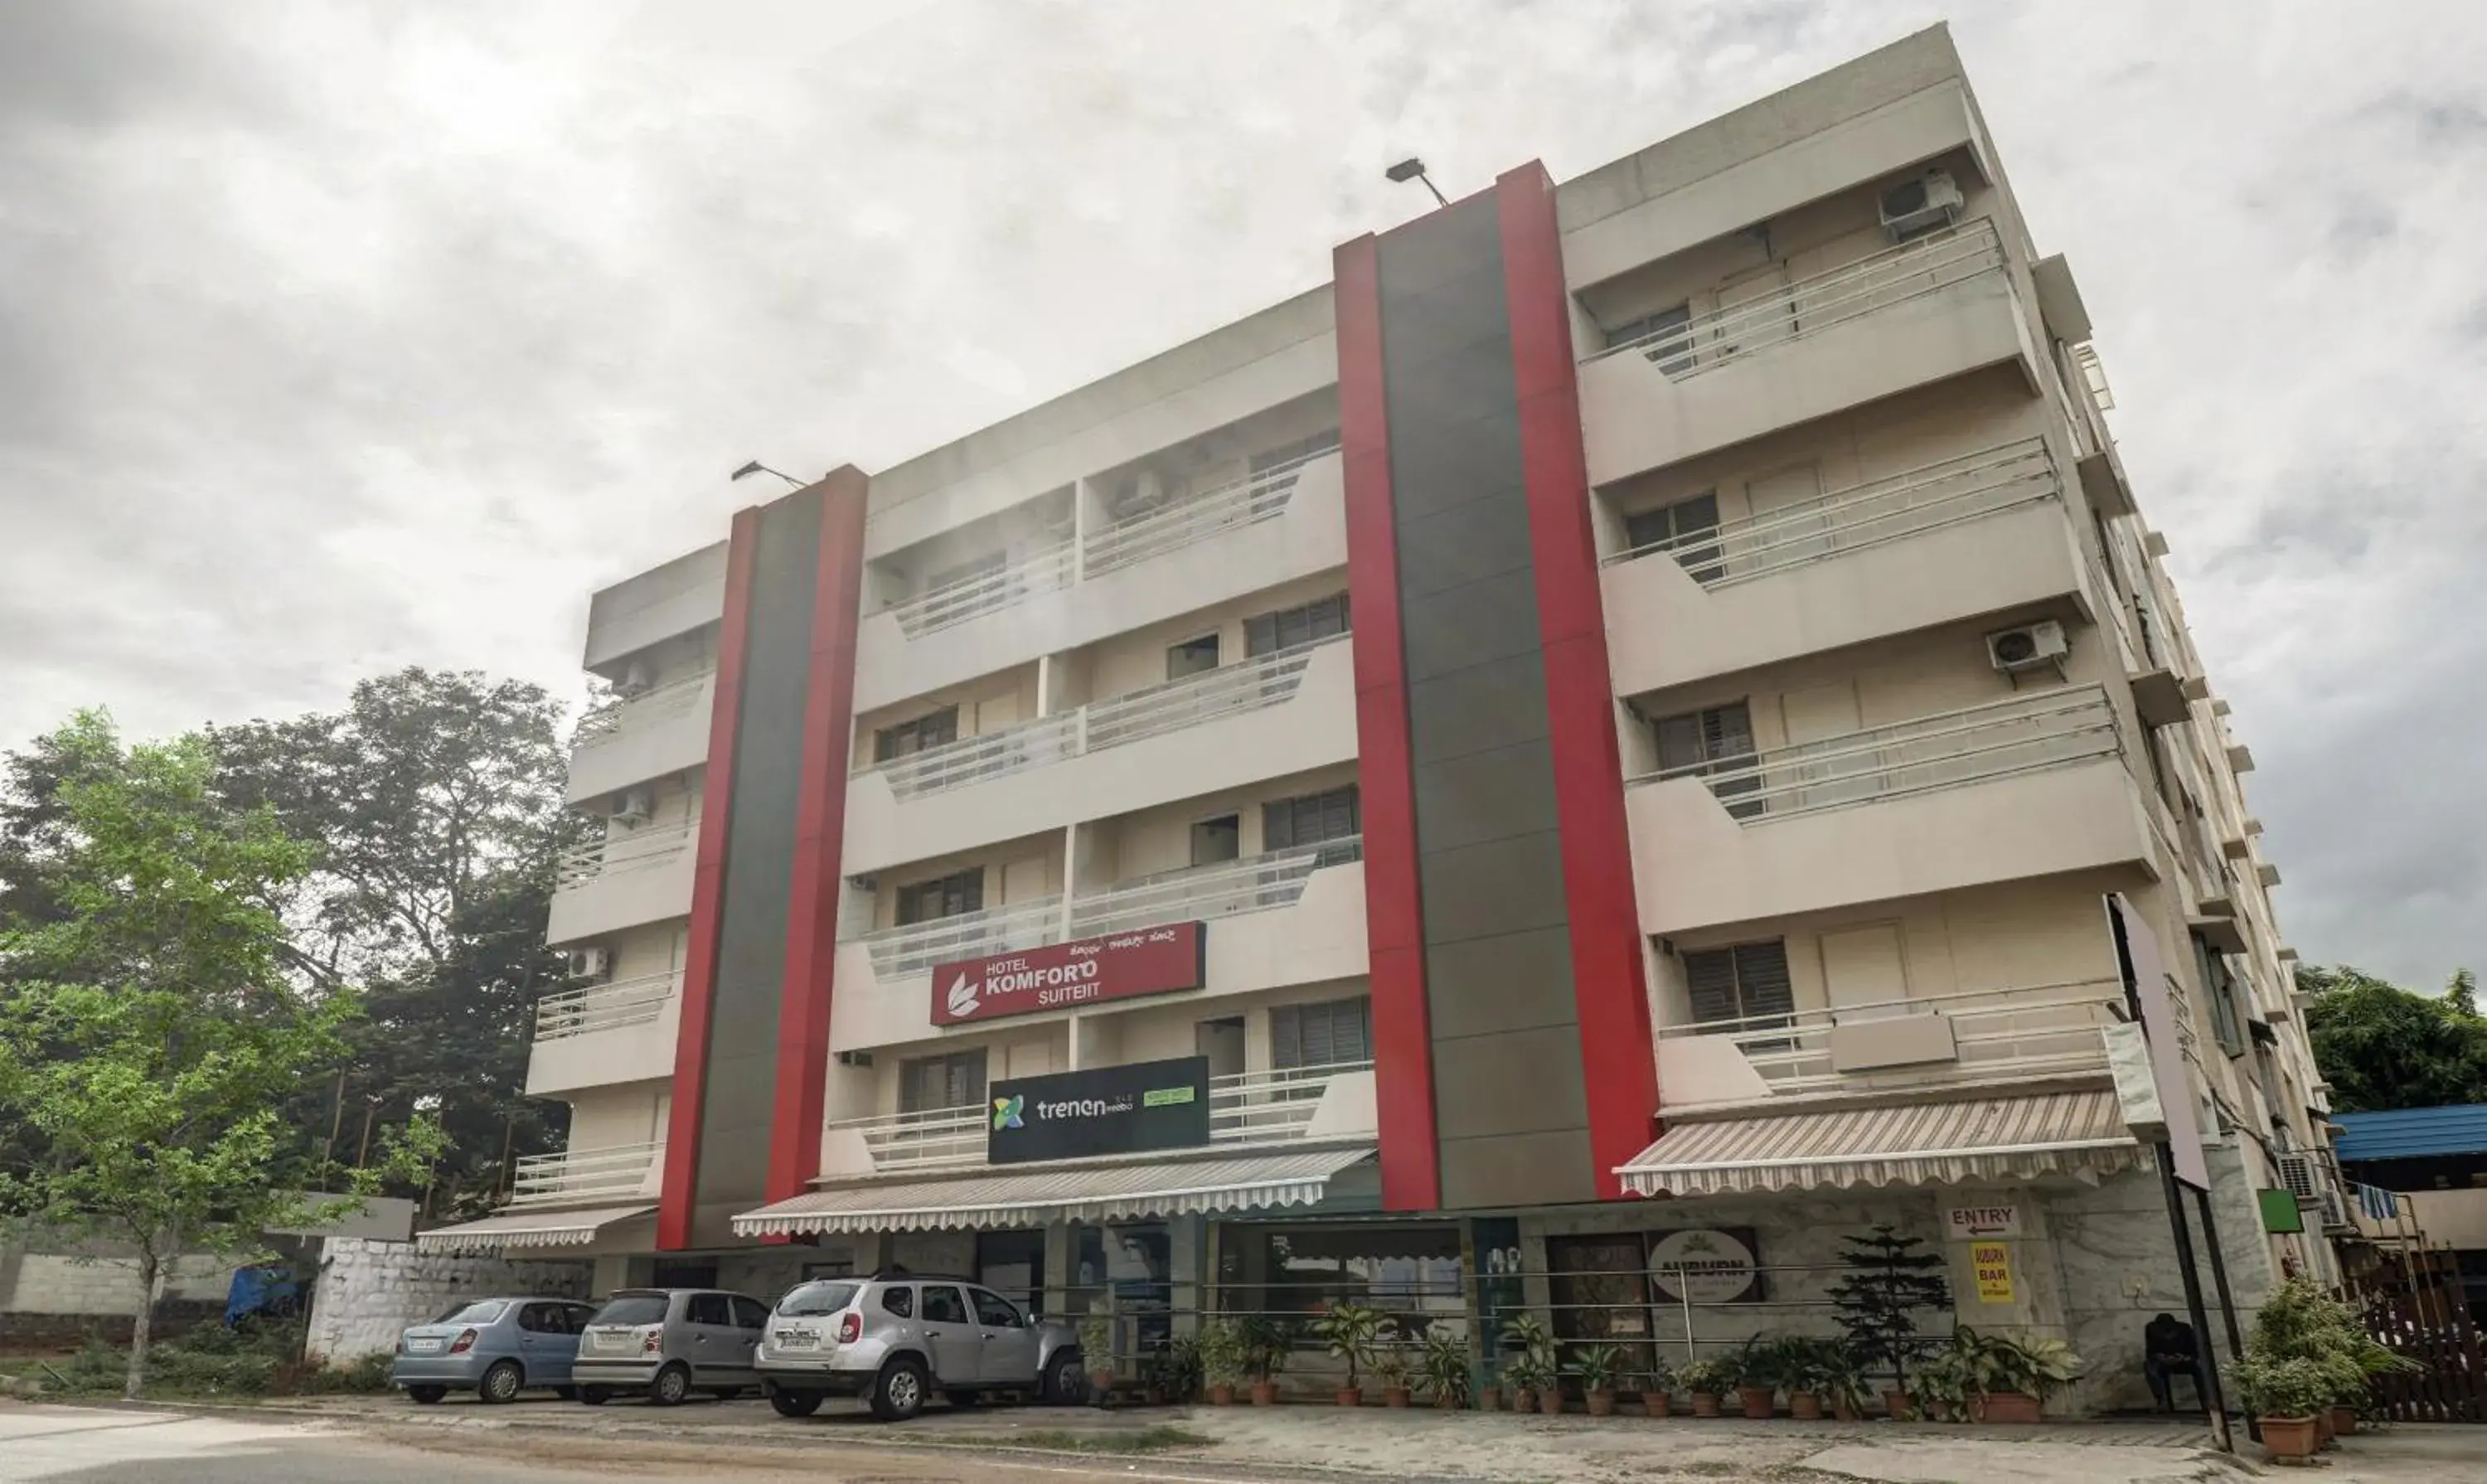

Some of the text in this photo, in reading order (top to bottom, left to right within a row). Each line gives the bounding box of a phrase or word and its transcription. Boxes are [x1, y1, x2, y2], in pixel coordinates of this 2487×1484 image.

[986, 958, 1030, 976] HOTEL
[1952, 1208, 2012, 1225] ENTRY
[1980, 1269, 2007, 1281] BAR
